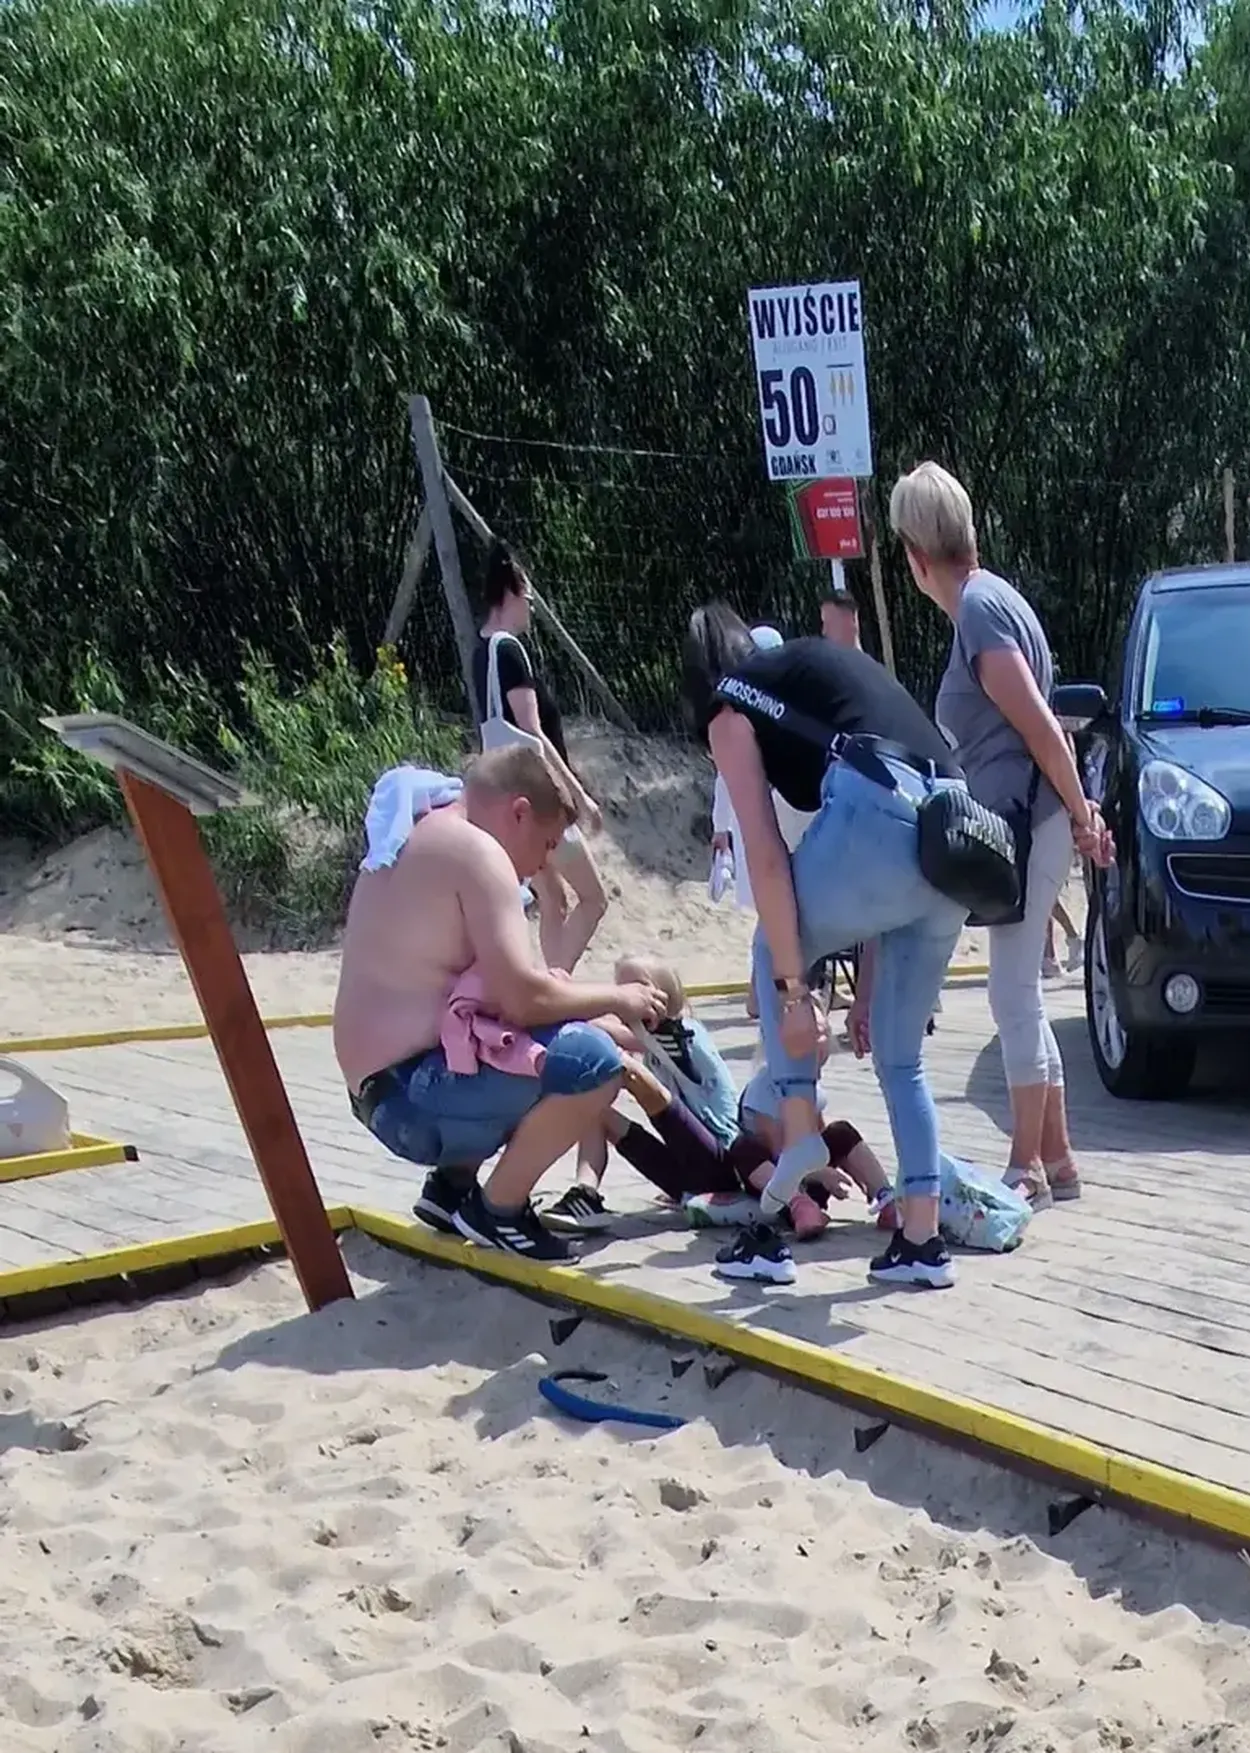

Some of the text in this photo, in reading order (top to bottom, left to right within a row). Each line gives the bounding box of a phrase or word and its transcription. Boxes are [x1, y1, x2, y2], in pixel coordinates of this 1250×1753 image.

[753, 288, 860, 339] WYJŚCIE
[760, 366, 820, 448] 50
[770, 451, 817, 477] GDAŃSK
[723, 677, 786, 720] MOSCHINO
